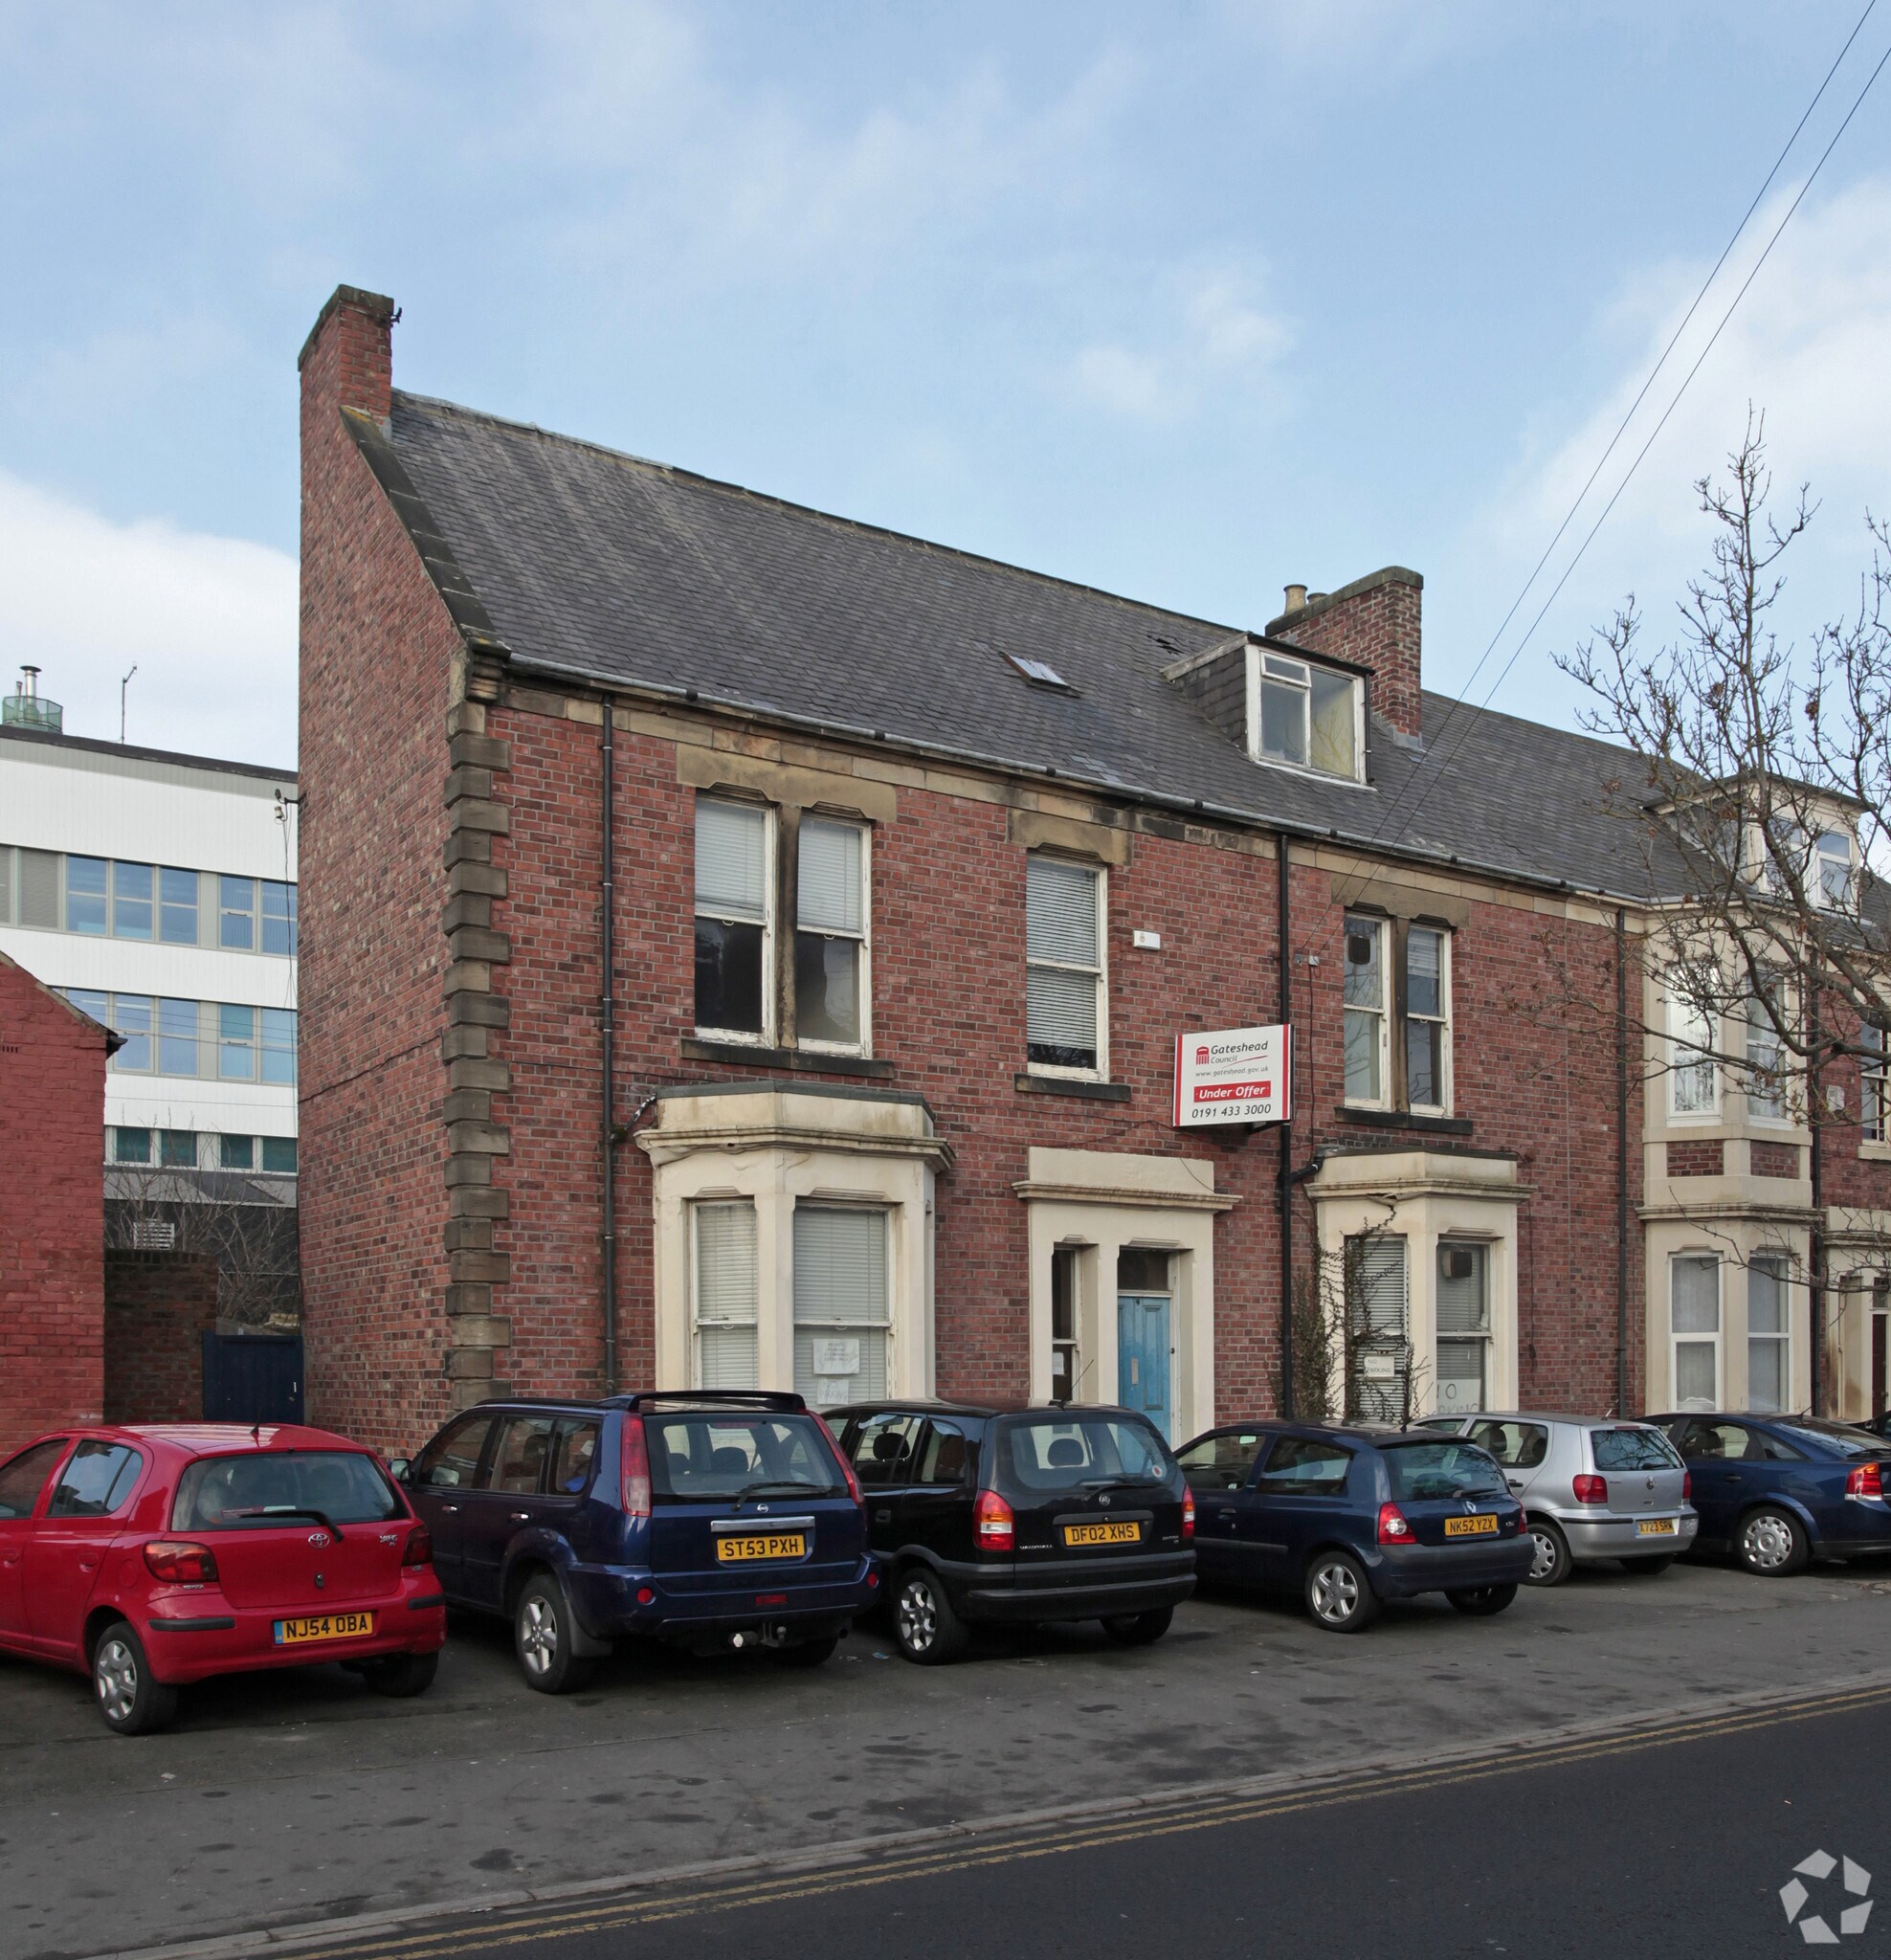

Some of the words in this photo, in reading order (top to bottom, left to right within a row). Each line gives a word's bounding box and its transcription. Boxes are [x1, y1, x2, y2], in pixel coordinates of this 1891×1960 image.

[1211, 1040, 1269, 1055] Gateshead
[1211, 1055, 1238, 1064] Council
[1195, 1066, 1269, 1078] www.gateshead.gov.uk
[1199, 1088, 1233, 1100] Under
[1235, 1085, 1265, 1098] Offer
[1191, 1107, 1217, 1119] 0191
[1221, 1105, 1240, 1117] 433
[1244, 1103, 1272, 1115] 3000
[1449, 1520, 1475, 1533] NK52
[1476, 1518, 1494, 1531] YZX
[1638, 1522, 1658, 1532] X723
[1071, 1527, 1106, 1542] DF02
[1109, 1526, 1135, 1539] XHS
[724, 1540, 766, 1557] ST53
[768, 1538, 799, 1554] PXH
[286, 1617, 330, 1638] NJ54
[336, 1615, 368, 1633] OBA
